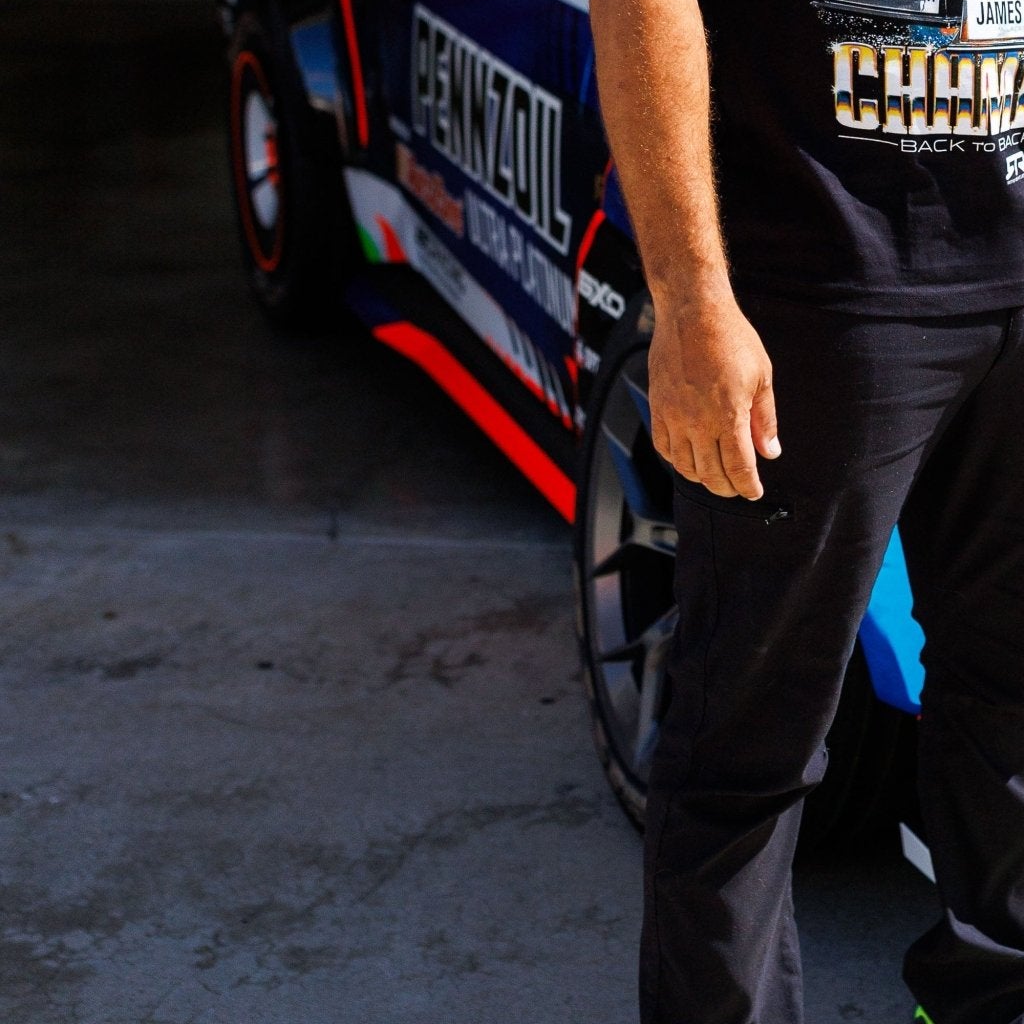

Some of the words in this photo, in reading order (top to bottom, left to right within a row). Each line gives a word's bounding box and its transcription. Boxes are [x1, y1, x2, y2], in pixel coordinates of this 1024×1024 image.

[976, 0, 1022, 26] JAMES
[411, 1, 572, 256] PENNZOIL
[901, 139, 965, 152] BACK
[972, 141, 996, 153] TO
